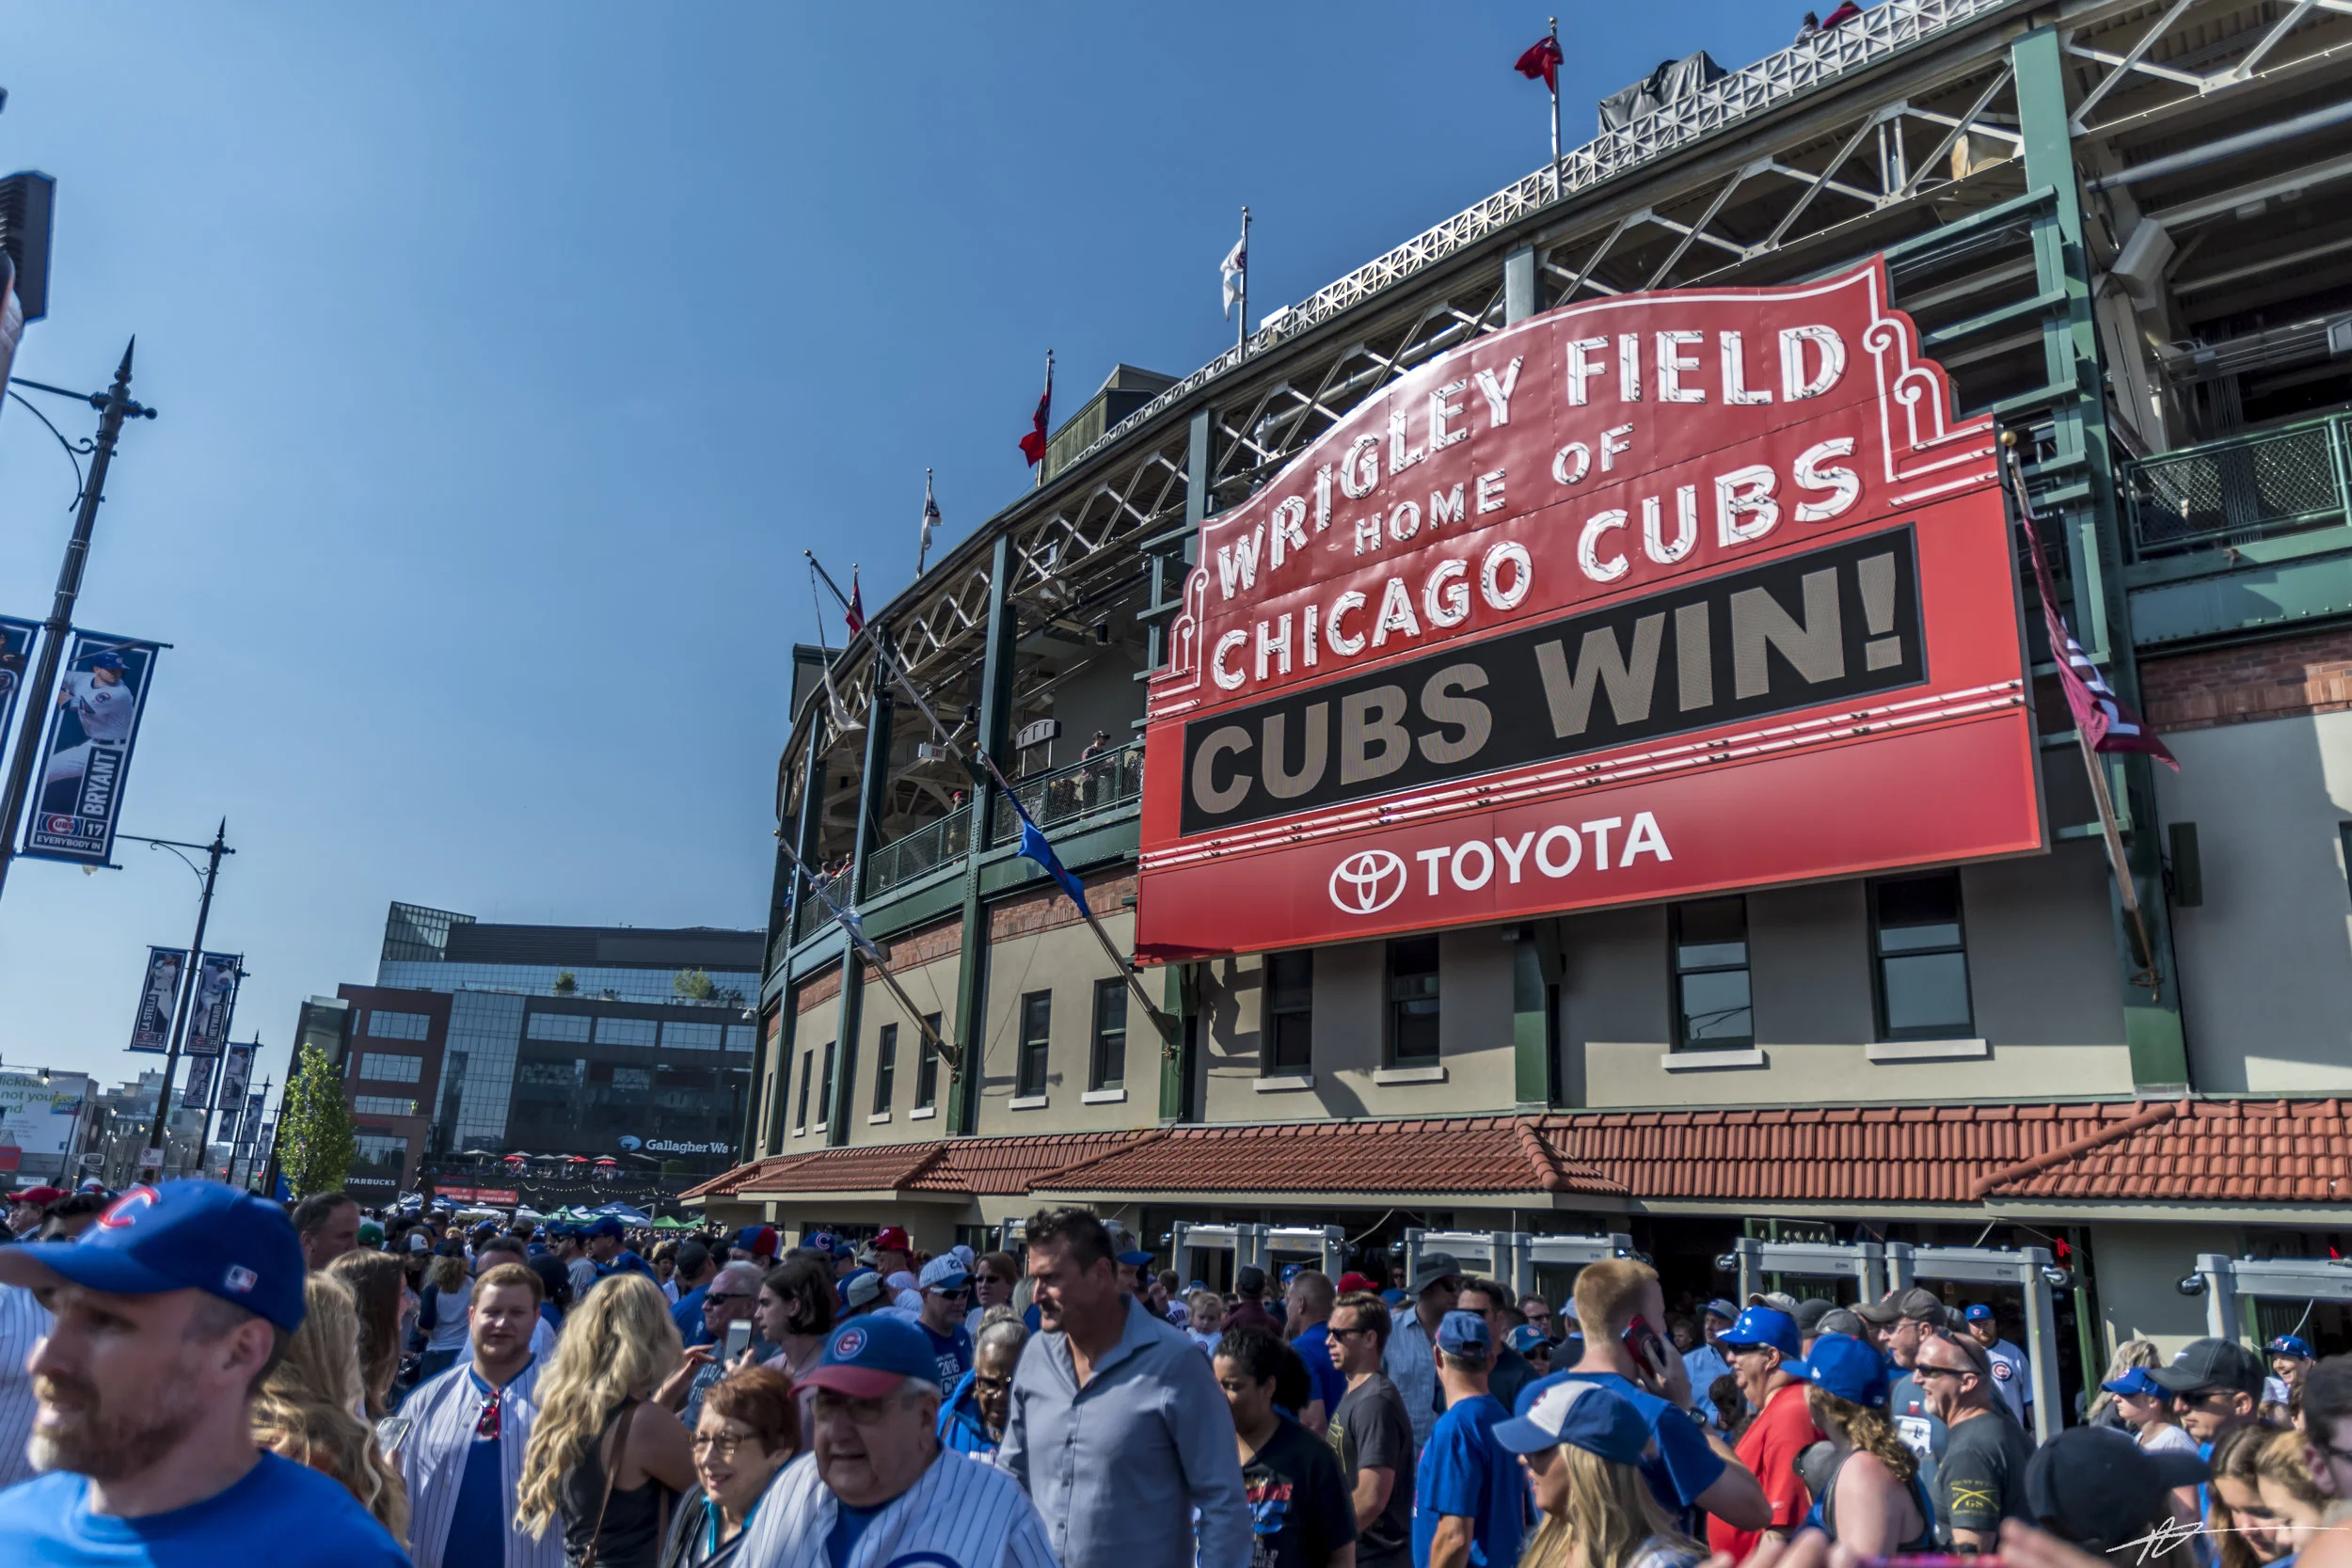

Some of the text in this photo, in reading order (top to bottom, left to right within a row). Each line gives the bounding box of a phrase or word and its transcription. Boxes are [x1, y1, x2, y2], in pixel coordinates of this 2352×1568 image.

[1216, 323, 1847, 600] WRIGLEY FIELD
[1354, 421, 1635, 557] HOME OF
[1212, 436, 1862, 691] CHICAGO CUBS
[1191, 662, 1493, 815] CUBS
[1534, 552, 1904, 739] WIN!
[83, 751, 117, 816] BRYANT
[36, 834, 102, 850] EVERYBODY IN
[87, 823, 104, 836] 17
[1416, 811, 1674, 897] TOYOTA
[141, 1022, 151, 1031] LA
[209, 1005, 223, 1037] HEYWARD
[645, 1138, 708, 1155] Gallagher
[343, 1177, 396, 1186] STARBUCKS
[815, 1232, 831, 1250] C
[937, 1357, 961, 1377] 2016
